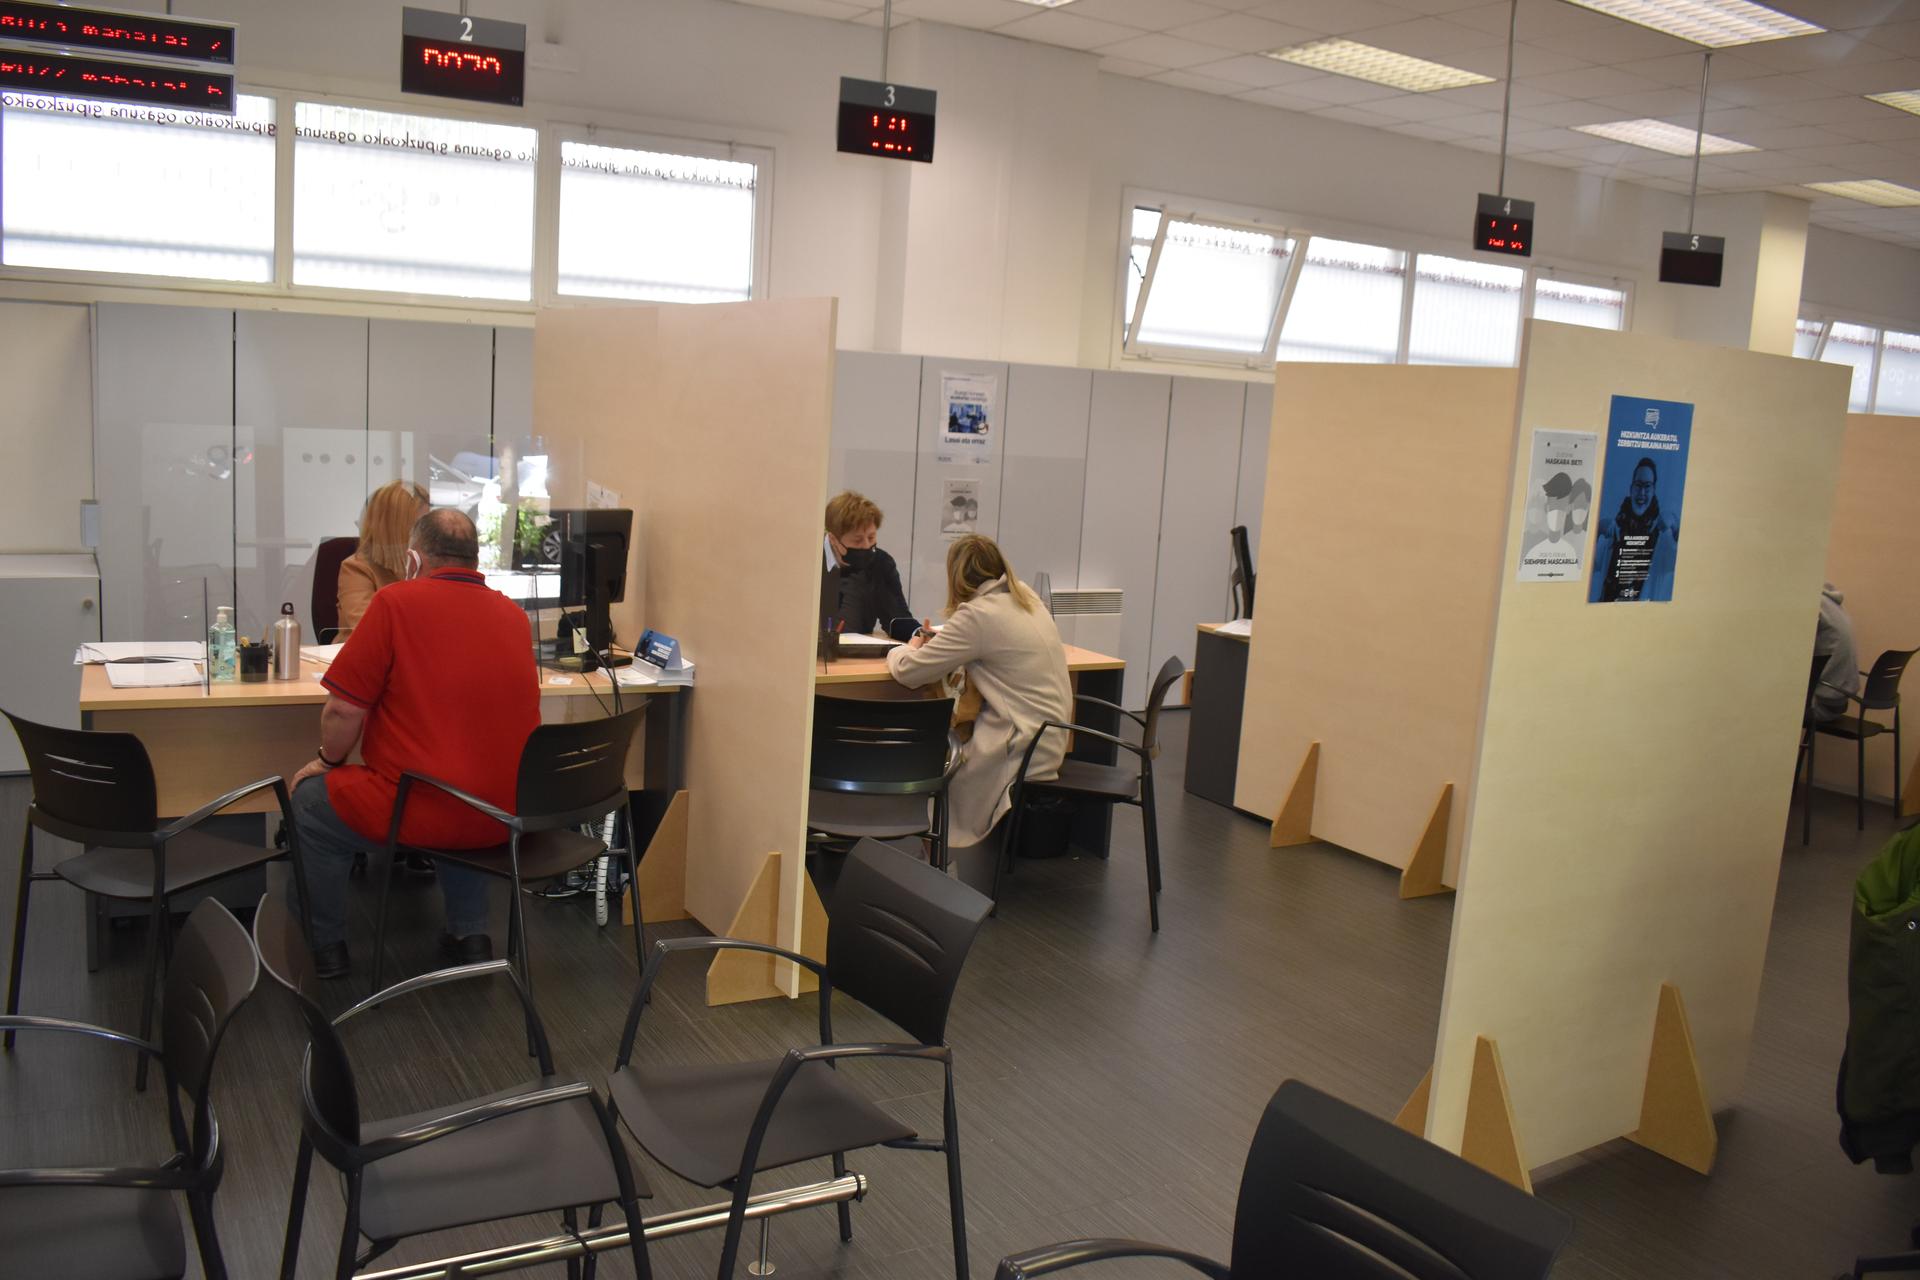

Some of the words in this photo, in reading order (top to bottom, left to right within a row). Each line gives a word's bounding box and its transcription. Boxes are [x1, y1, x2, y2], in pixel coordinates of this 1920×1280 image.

[460, 17, 473, 42] 2
[884, 85, 896, 107] 3
[1503, 199, 1512, 216] 4
[1690, 235, 1700, 251] 5
